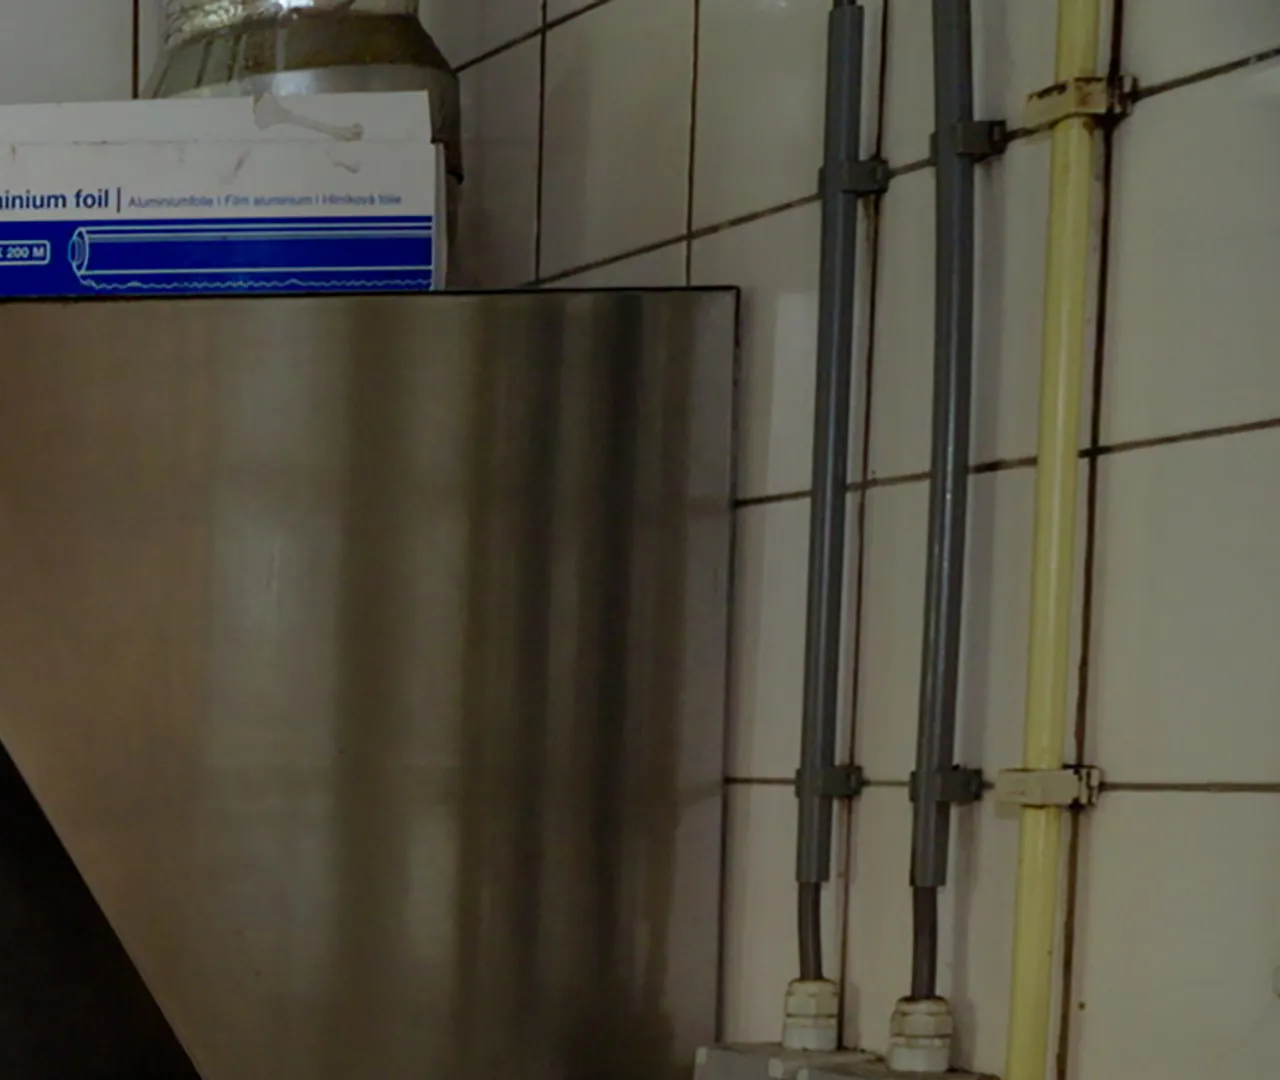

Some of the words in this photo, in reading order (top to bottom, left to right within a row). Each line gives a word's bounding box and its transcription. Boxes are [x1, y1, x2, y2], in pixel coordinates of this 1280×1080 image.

[75, 188, 109, 208] foil
[6, 246, 30, 258] 200
[32, 245, 46, 257] M
